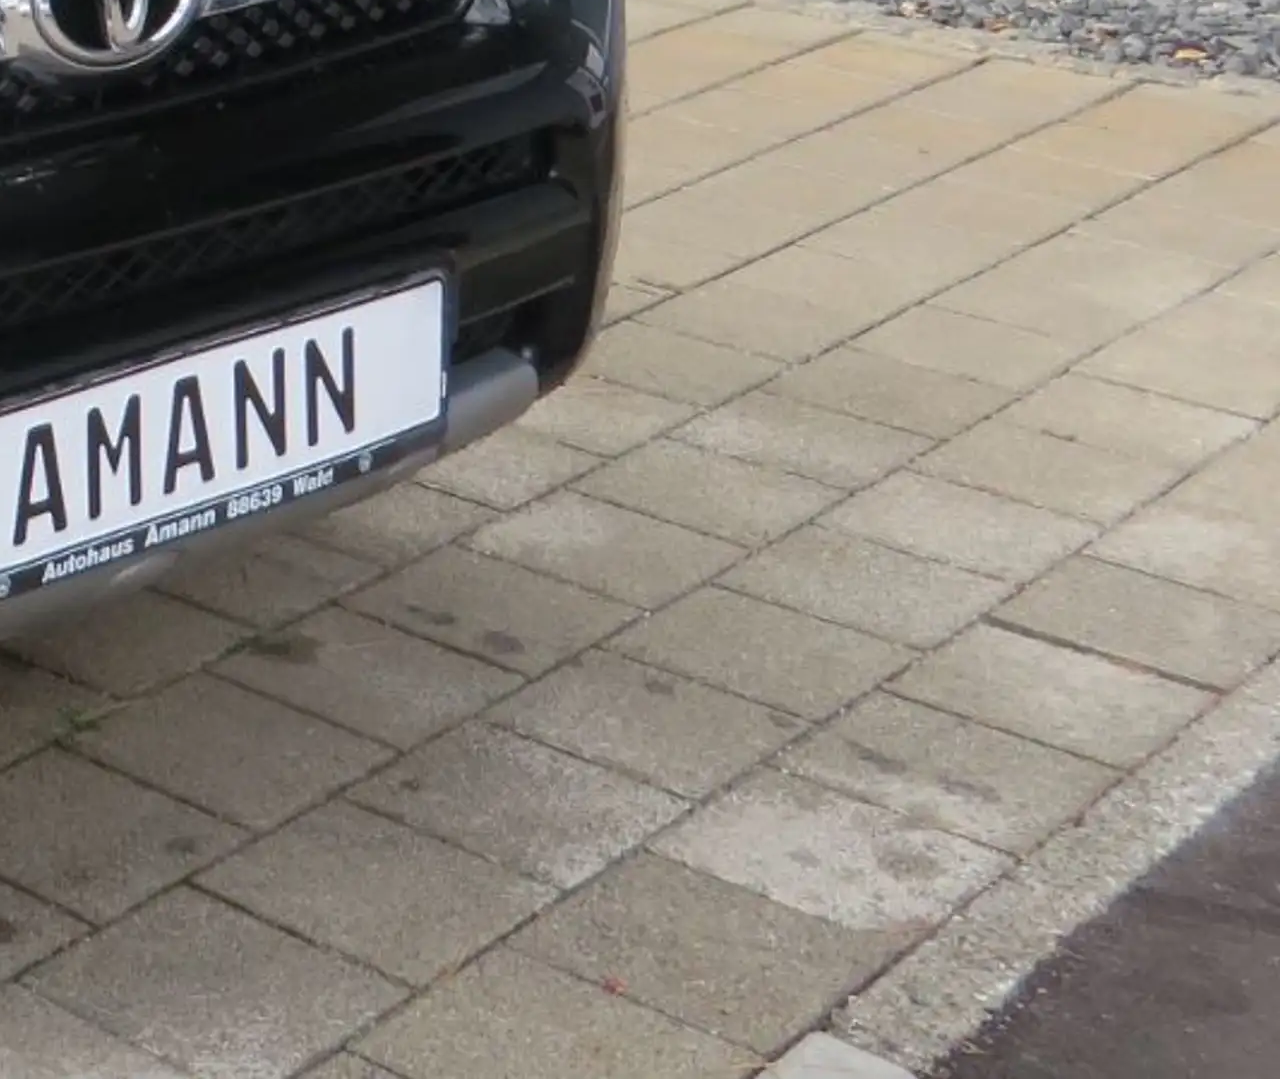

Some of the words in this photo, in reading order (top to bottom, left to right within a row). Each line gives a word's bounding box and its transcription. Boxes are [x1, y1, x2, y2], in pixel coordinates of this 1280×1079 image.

[12, 327, 355, 546] AMANN
[42, 537, 135, 584] Autohaus
[145, 508, 216, 548] Amann
[226, 484, 283, 519] 88639
[293, 467, 334, 497] Wald
